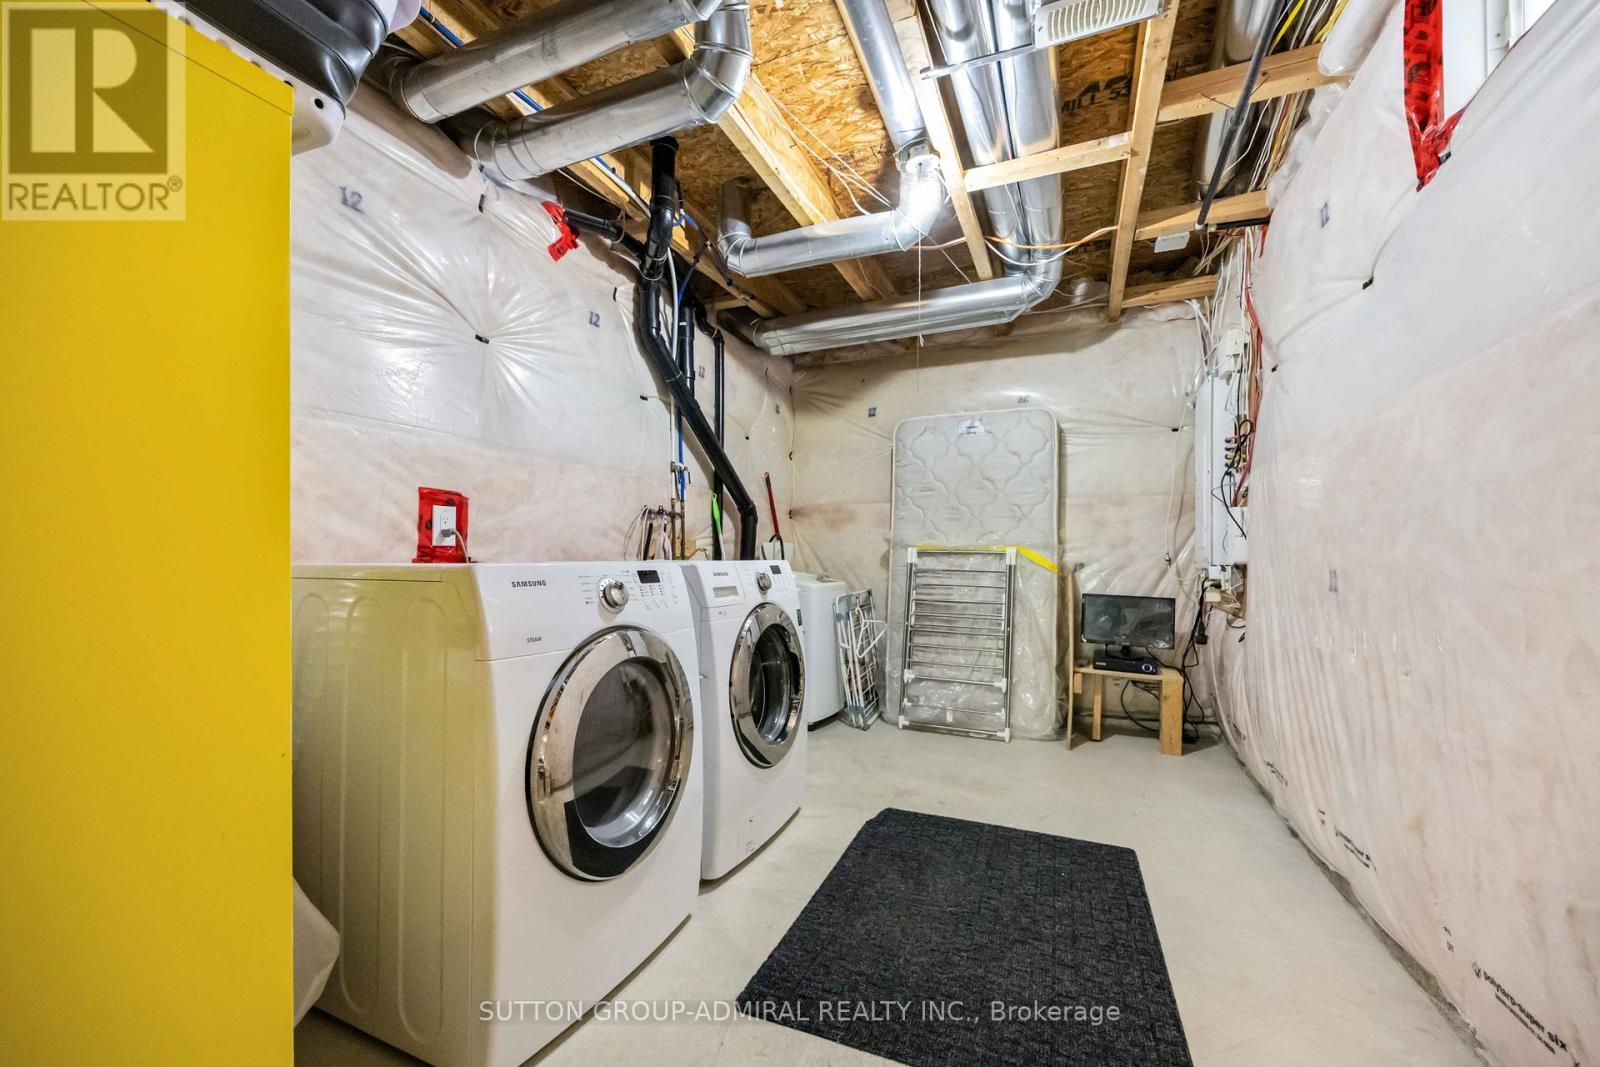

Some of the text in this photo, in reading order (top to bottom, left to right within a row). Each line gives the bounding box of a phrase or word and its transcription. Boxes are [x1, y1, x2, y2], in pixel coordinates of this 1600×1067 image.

[589, 311, 602, 329] 12
[511, 579, 547, 589] SAMSUNG
[526, 636, 543, 644] STEAM
